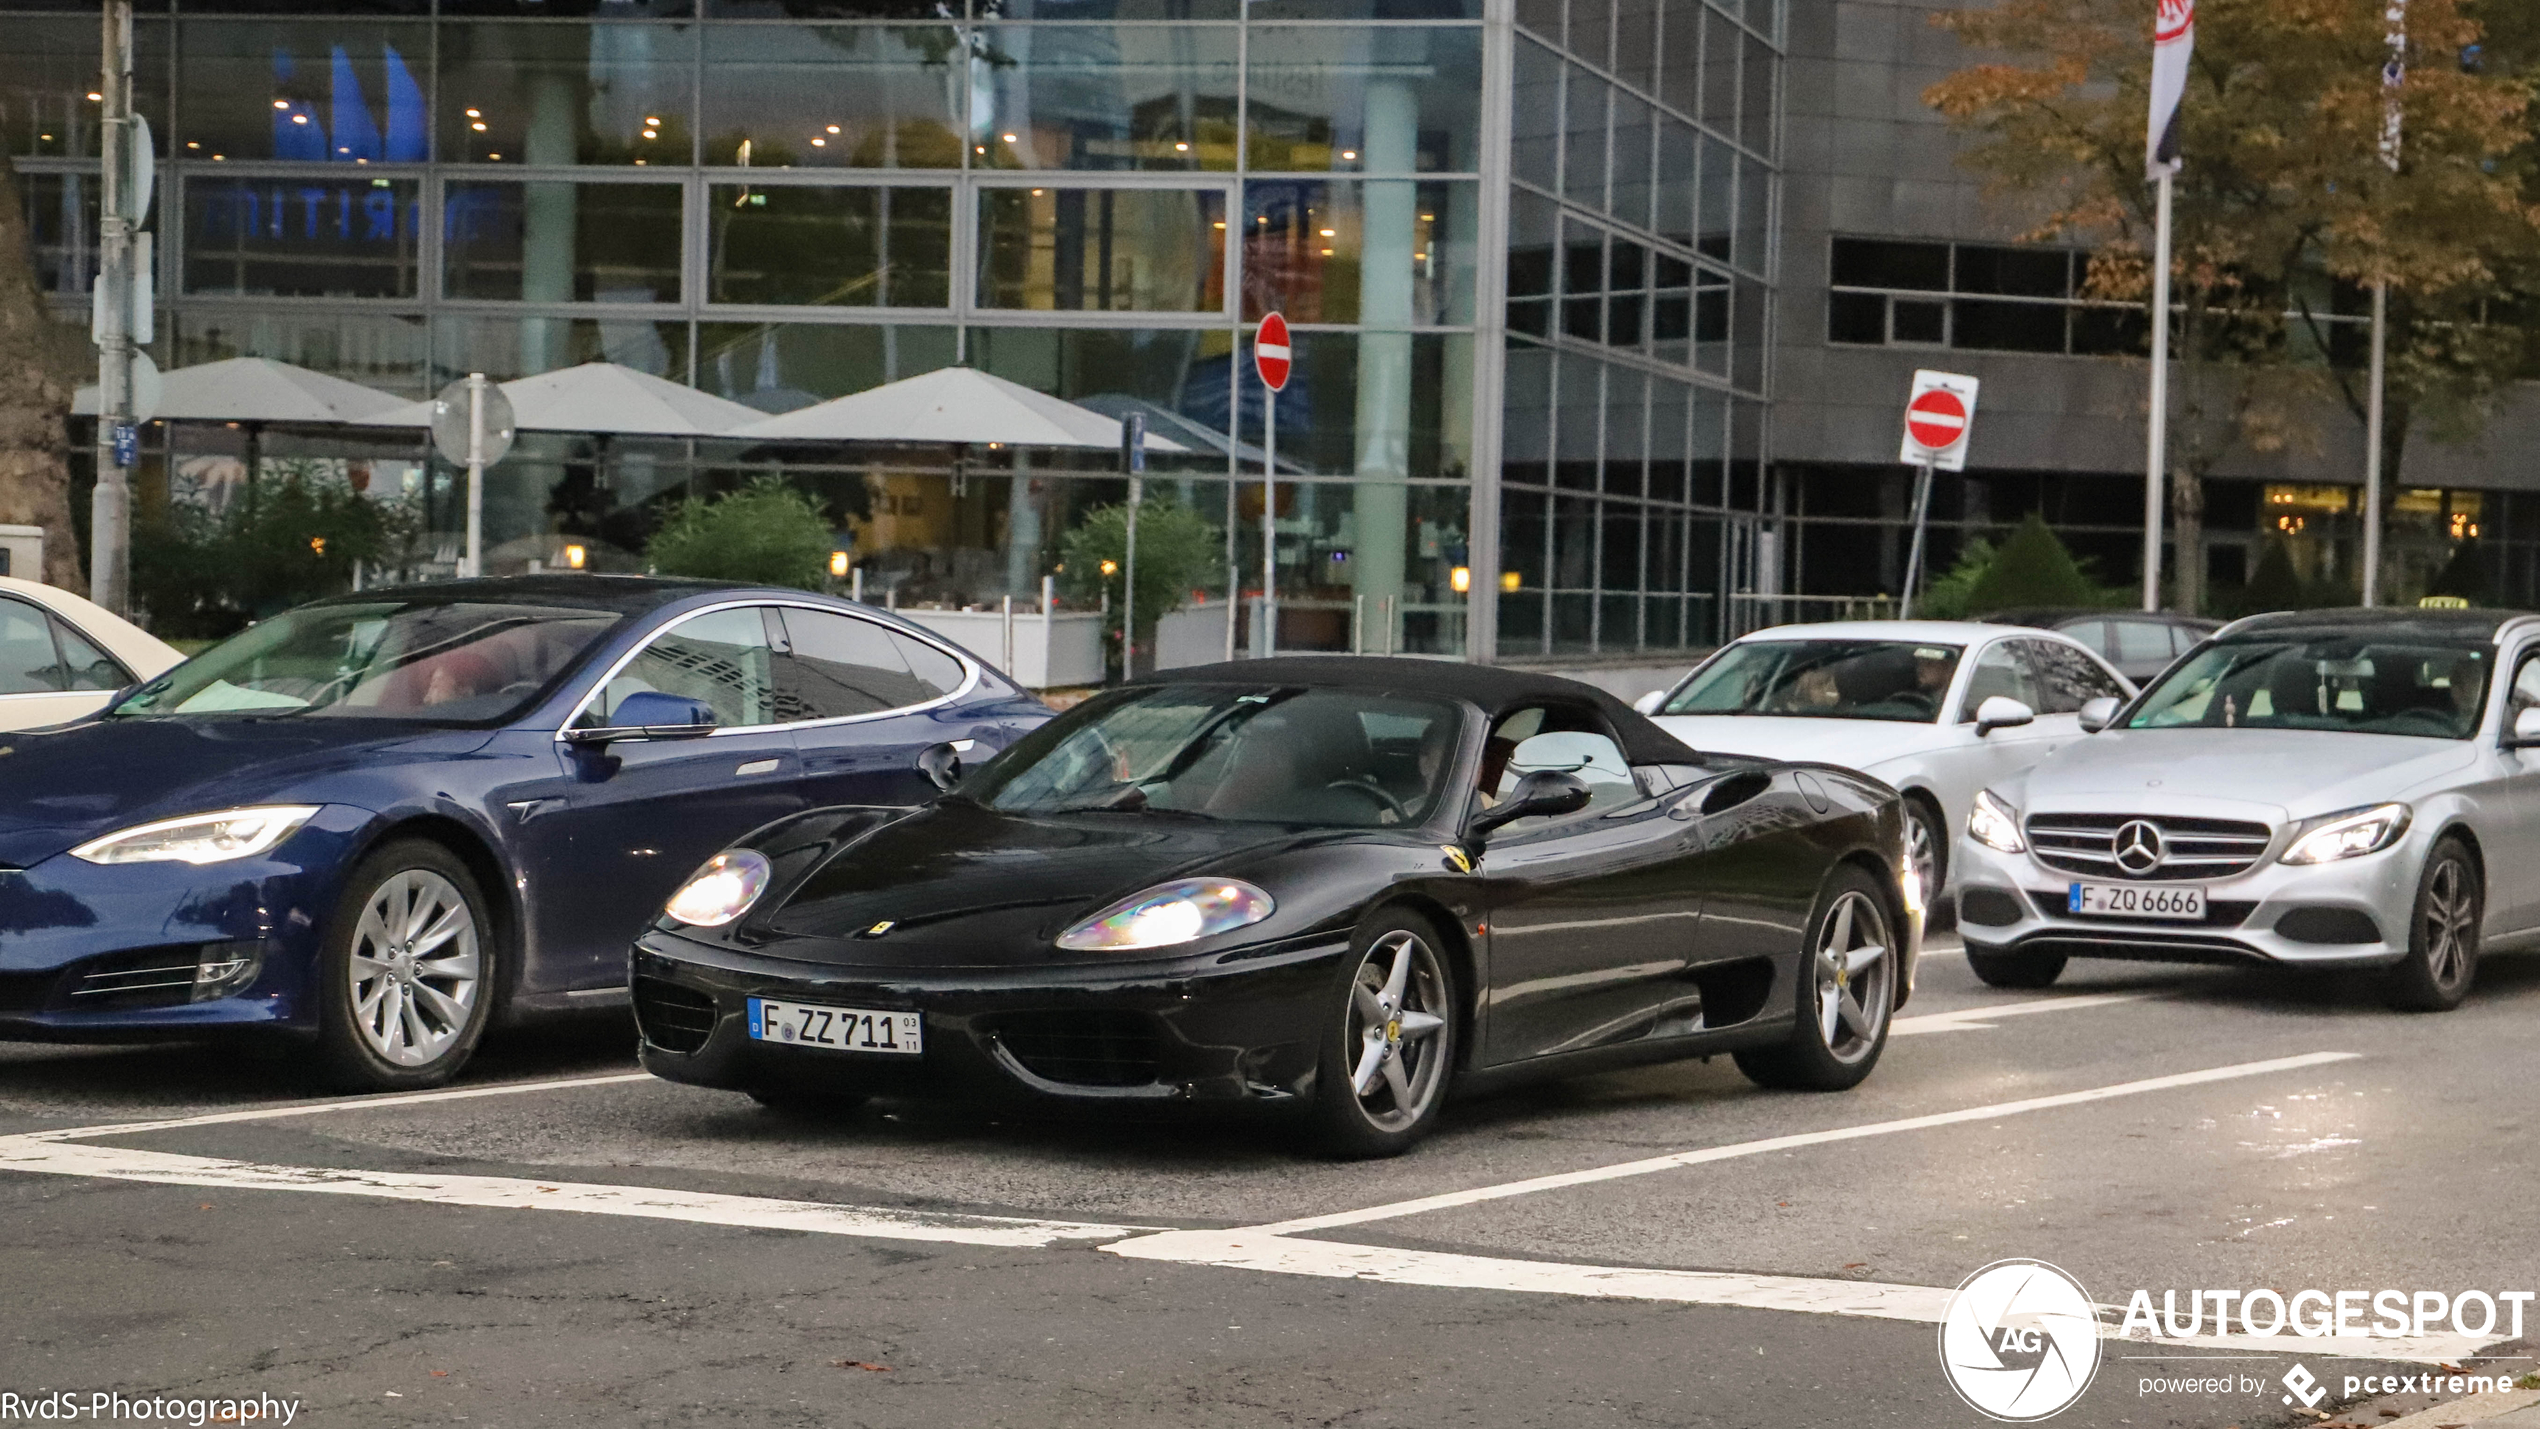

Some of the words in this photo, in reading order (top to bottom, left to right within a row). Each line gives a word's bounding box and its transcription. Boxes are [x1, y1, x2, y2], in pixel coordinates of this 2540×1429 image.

[2082, 887, 2094, 908] F
[2109, 889, 2136, 911] ZQ
[2142, 891, 2198, 913] 6666
[764, 1004, 779, 1036] F
[799, 1008, 834, 1044] ZZ
[841, 1012, 898, 1049] 711
[903, 1017, 917, 1027] 03
[905, 1040, 918, 1051] 11
